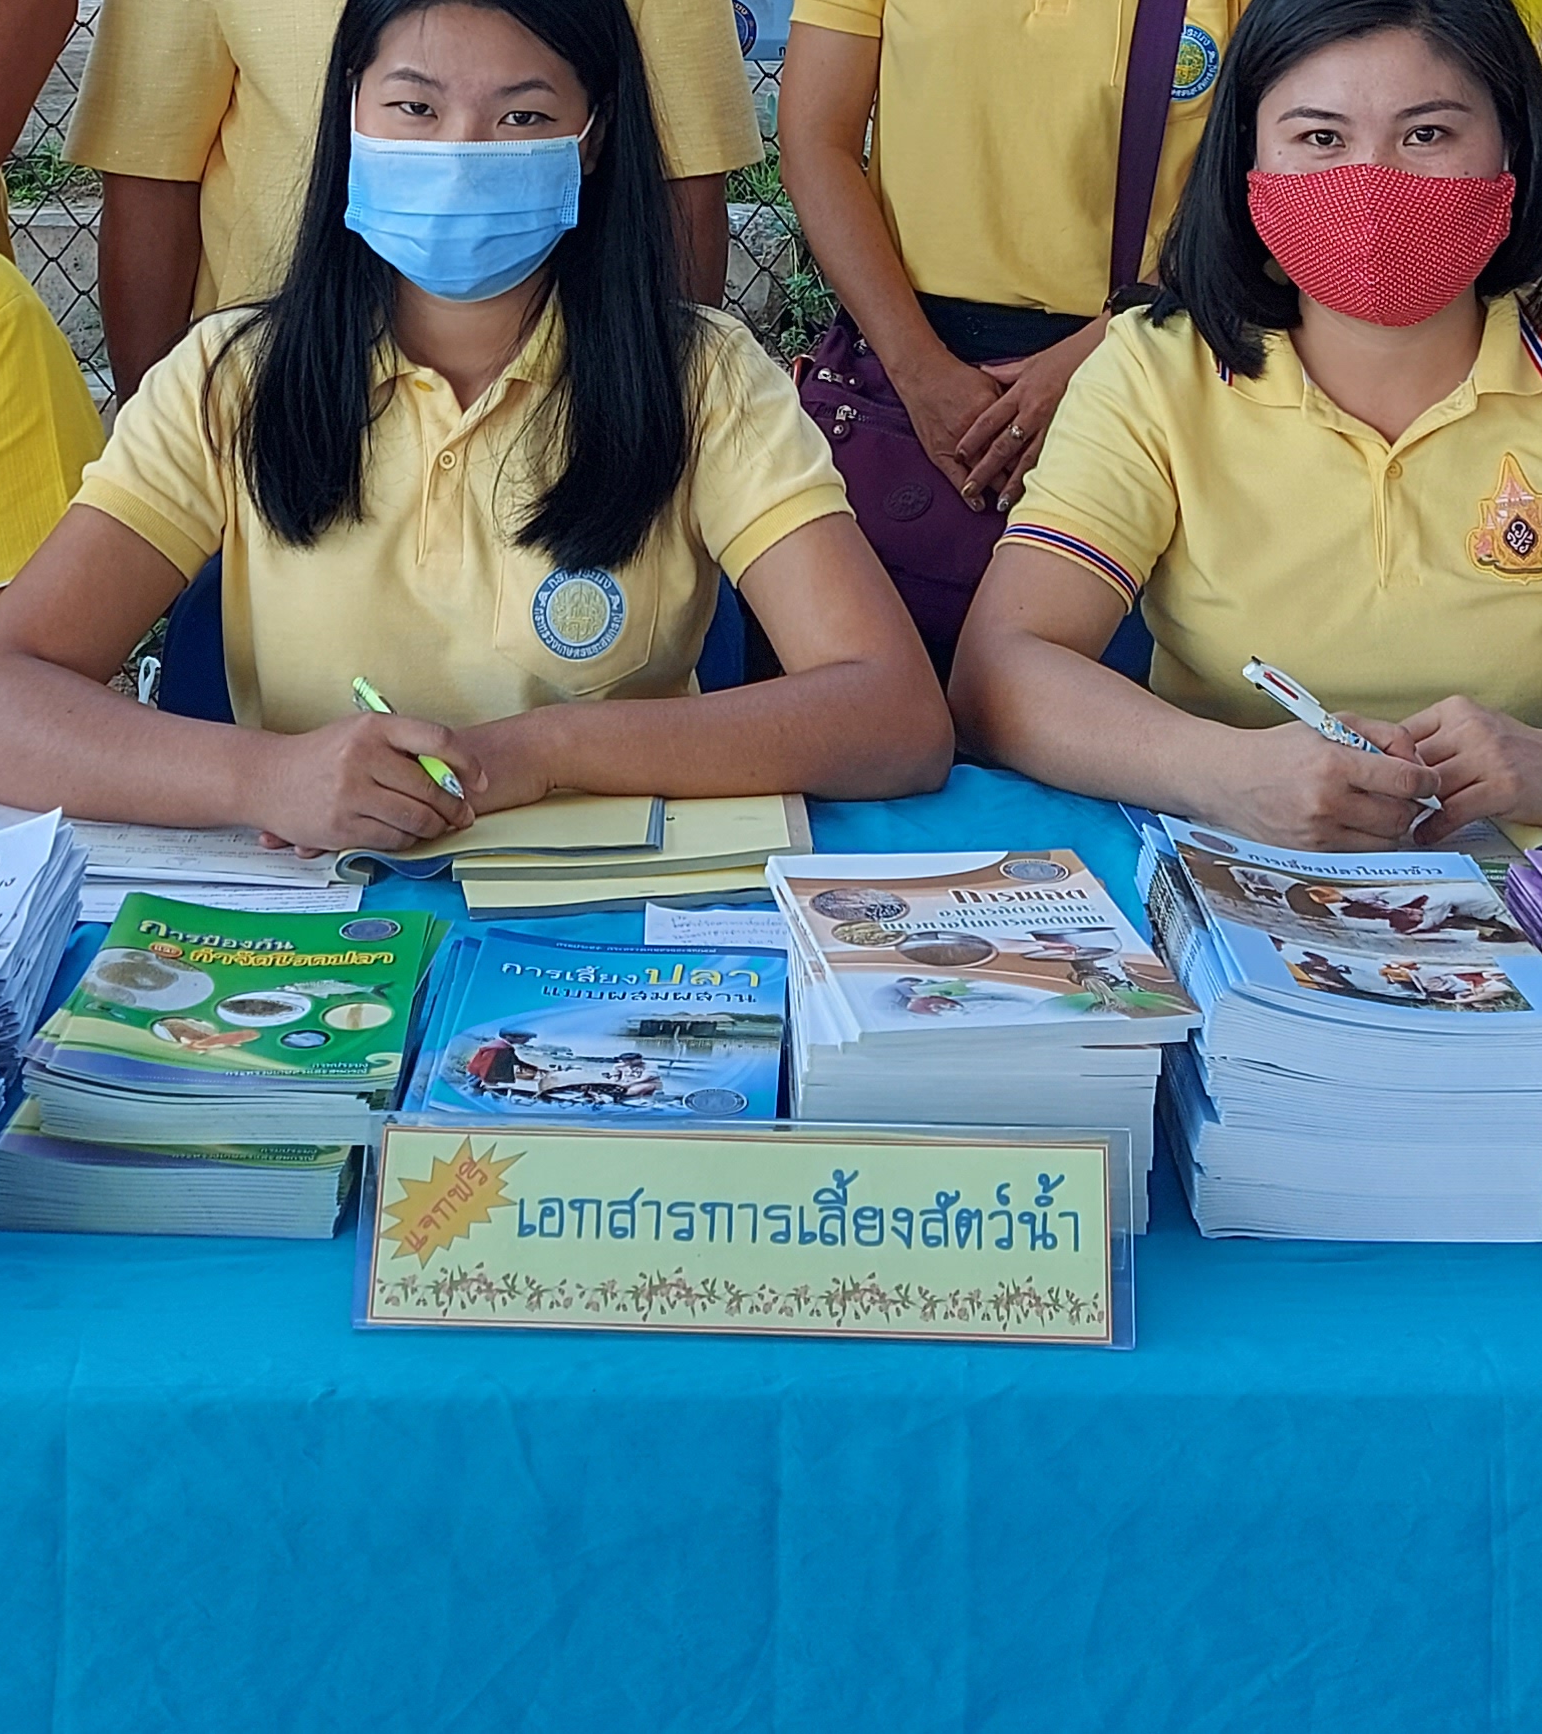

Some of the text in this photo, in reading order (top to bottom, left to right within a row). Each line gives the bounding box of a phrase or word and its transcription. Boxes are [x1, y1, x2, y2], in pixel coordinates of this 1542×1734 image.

[1247, 852, 1443, 877] การเลี้ยงปลาในนาข้าว
[139, 918, 295, 951] การป้องกัน
[190, 948, 395, 968] กำจัดโรคปลา
[541, 985, 758, 1004] แบบผสมผสาน
[400, 1152, 494, 1253] แจกฟรี
[516, 1168, 1083, 1254] เอกสารการเลี้ยงสัตว์น้ำ
